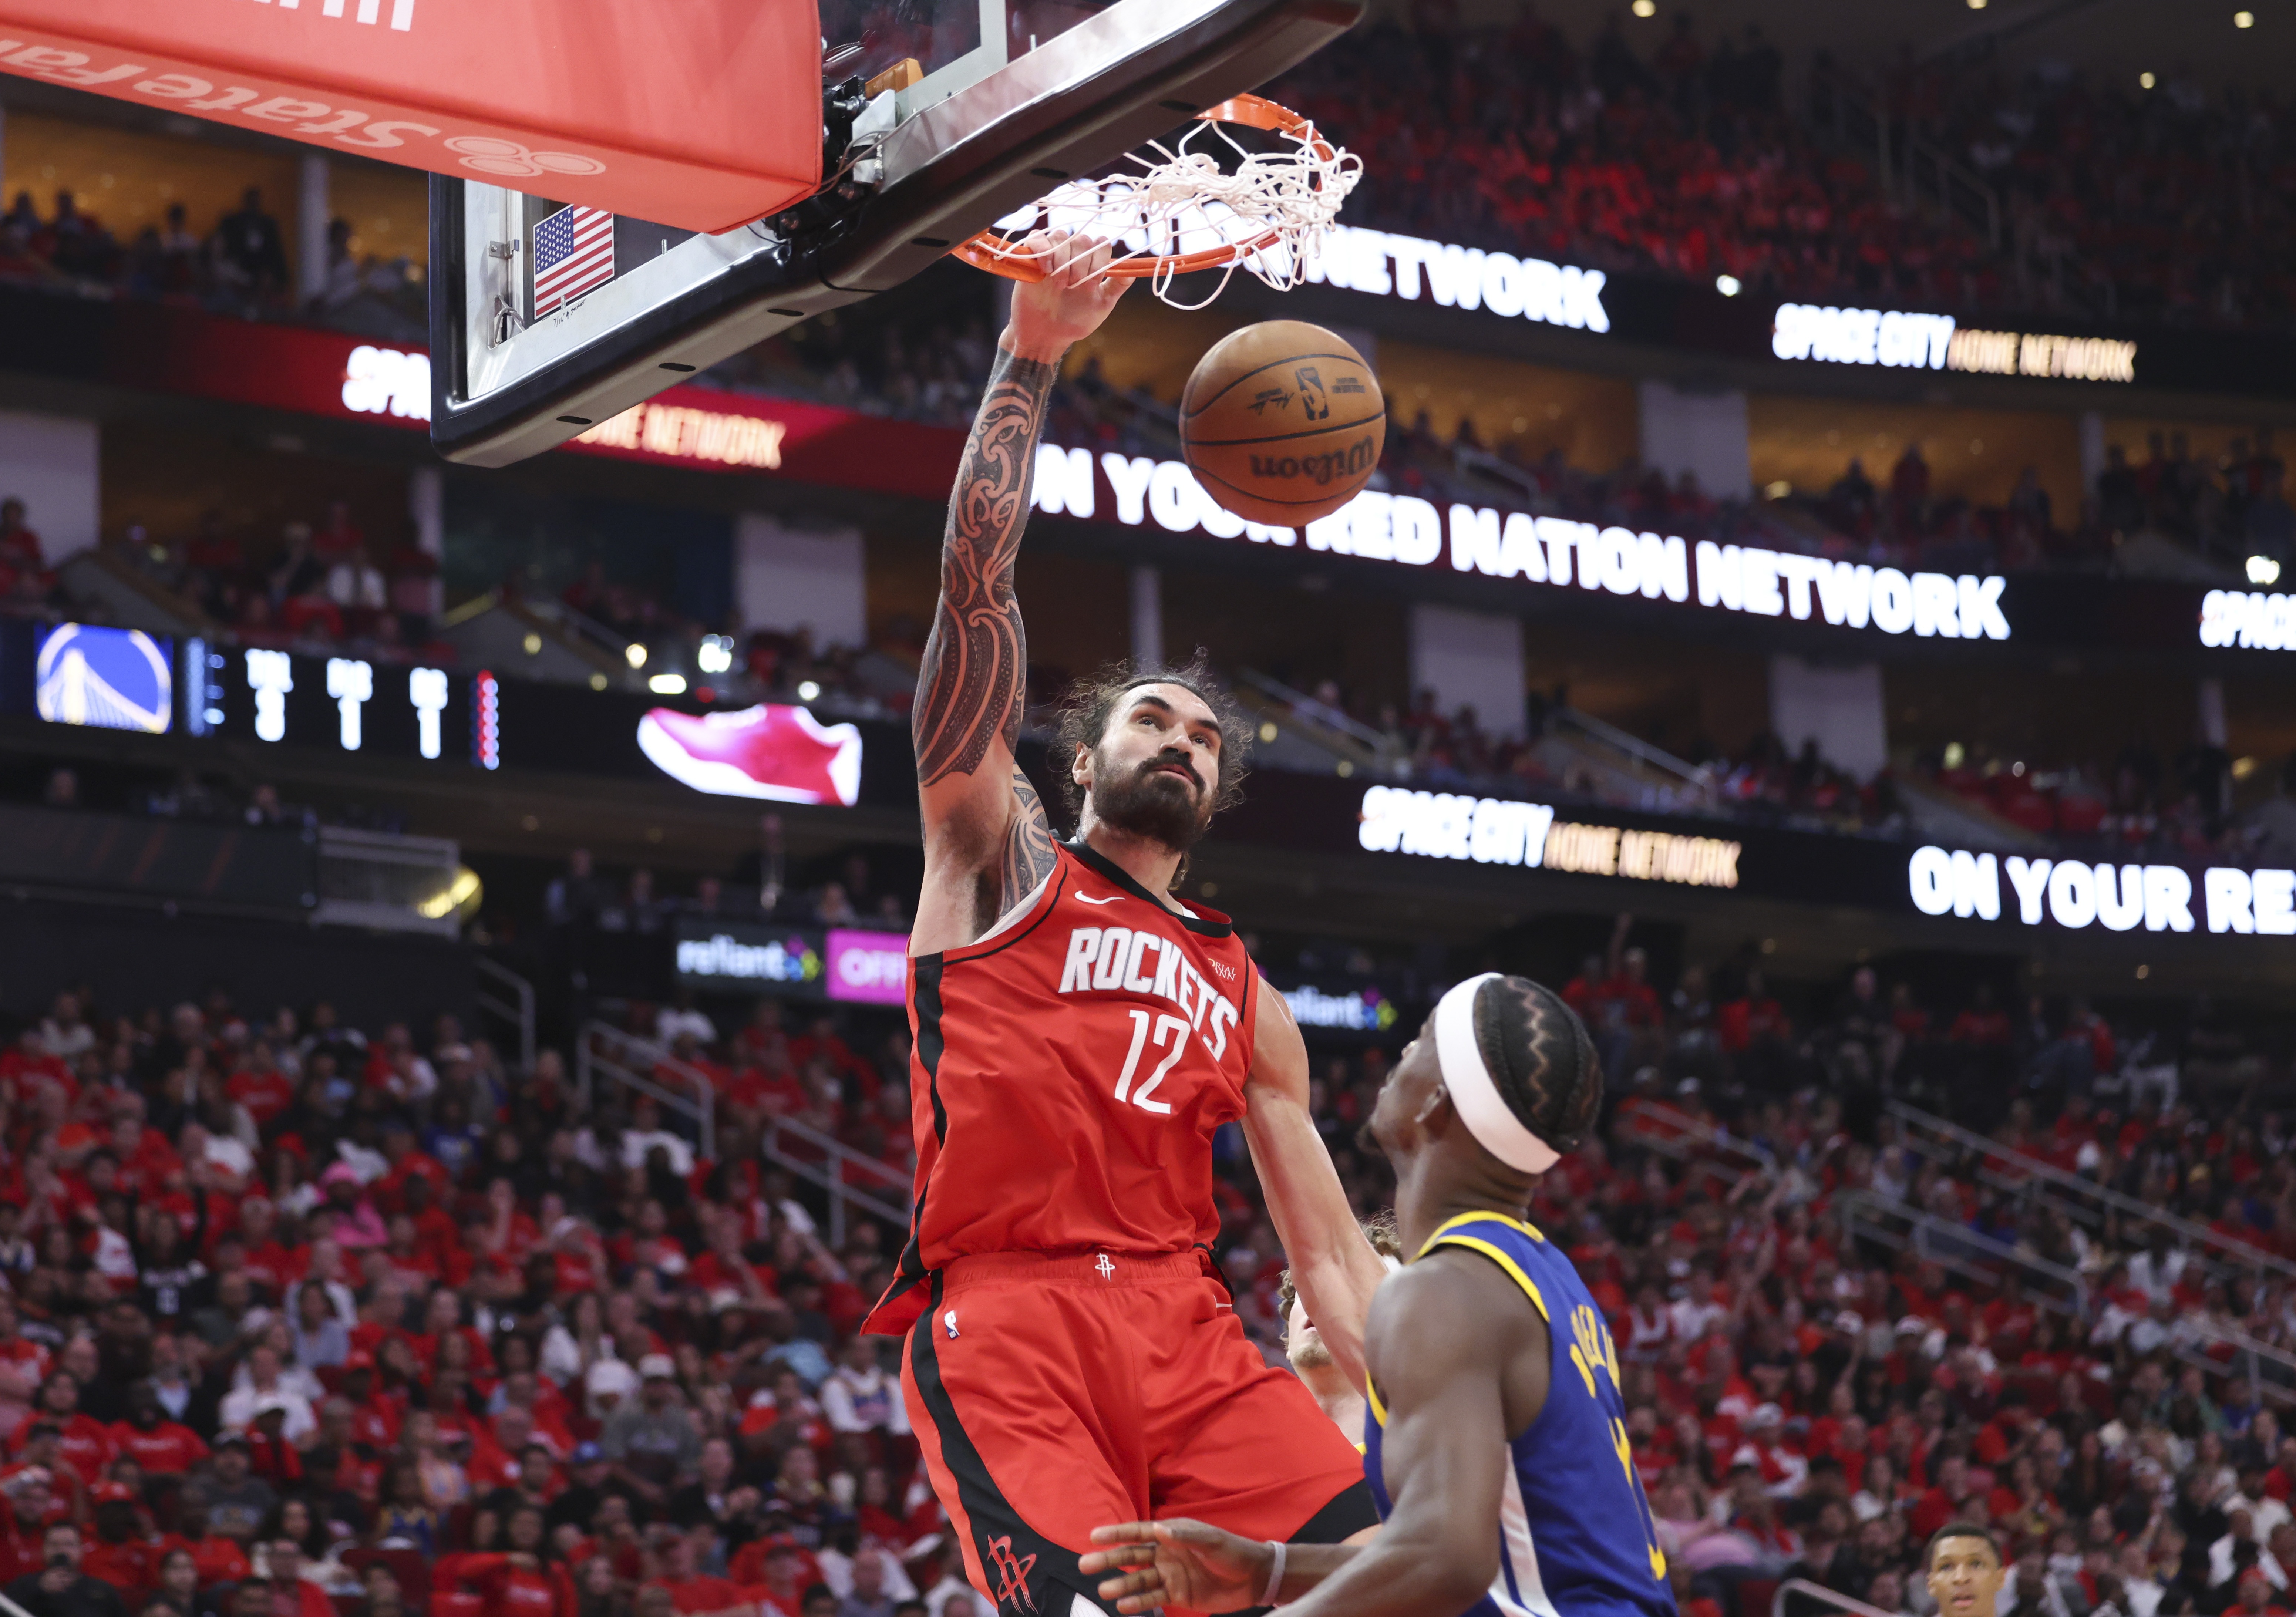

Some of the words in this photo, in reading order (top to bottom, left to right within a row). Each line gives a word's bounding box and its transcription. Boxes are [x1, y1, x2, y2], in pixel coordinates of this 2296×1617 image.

[132, 74, 441, 148] State
[1304, 223, 1610, 333] NETWORK
[342, 345, 431, 421] SPA
[1249, 435, 1374, 486] Wilson
[1030, 443, 1095, 518] N
[1449, 503, 1688, 603] NATION
[1696, 540, 2011, 640] NETWORK
[1909, 845, 2001, 921] ON
[2004, 855, 2195, 932] YOUR
[1058, 927, 1238, 1062] ROCKETS
[1114, 1009, 1191, 1114] 12
